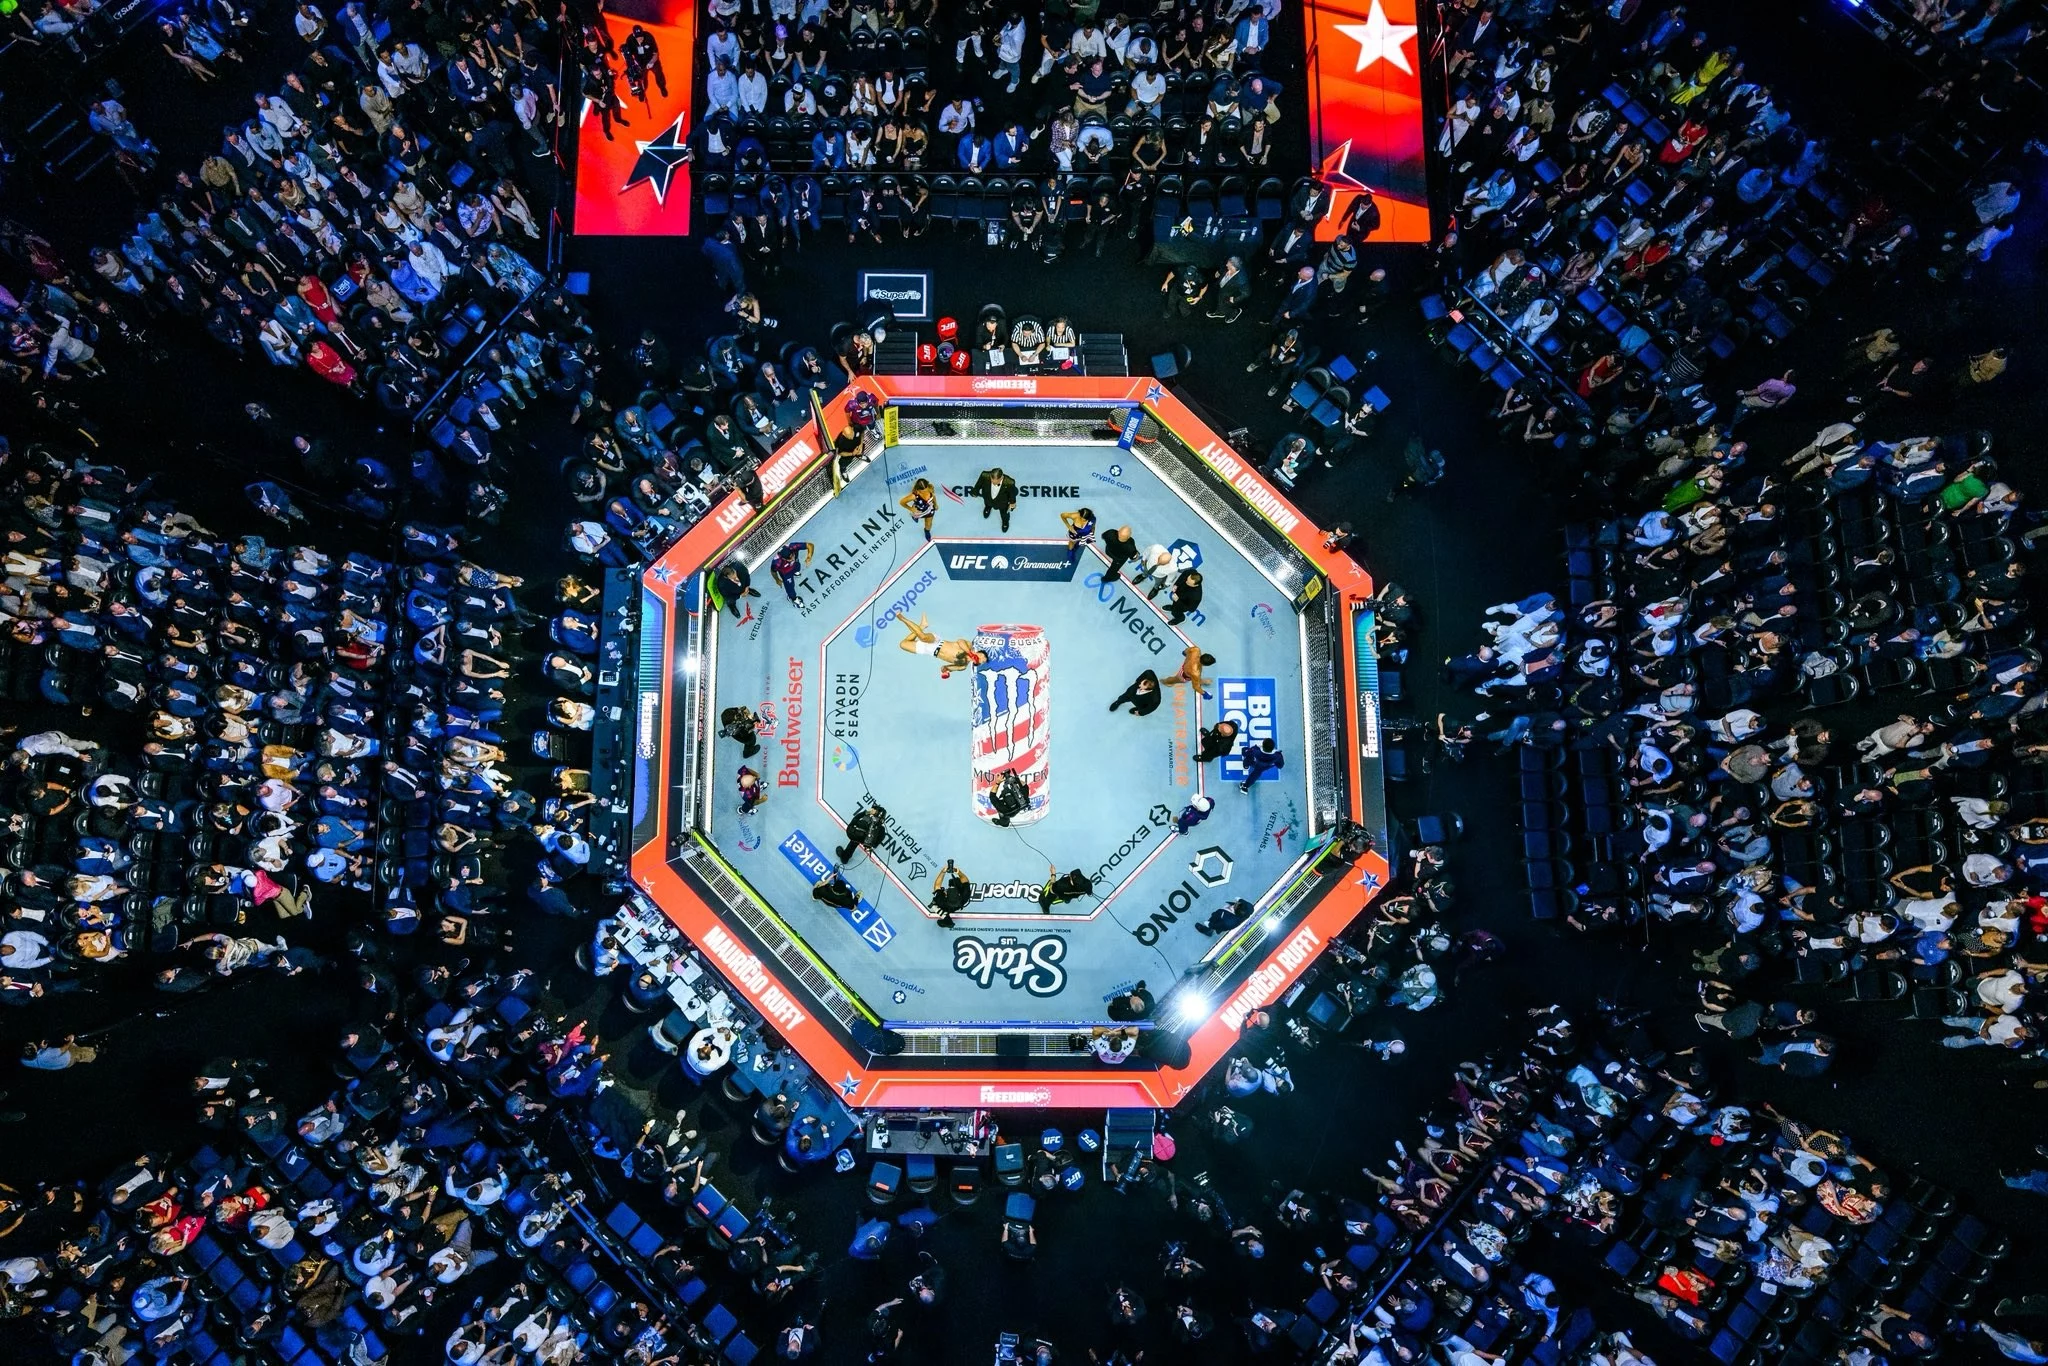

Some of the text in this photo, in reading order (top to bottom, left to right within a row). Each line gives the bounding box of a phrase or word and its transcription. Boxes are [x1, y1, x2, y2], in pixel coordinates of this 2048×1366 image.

[941, 321, 957, 332] UFC
[923, 344, 931, 361] UFC
[956, 351, 967, 369] UFC
[989, 379, 1037, 389] FREEDOM
[896, 464, 929, 482] AMSTERDAM
[1198, 440, 1243, 479] RUFFY
[951, 484, 1080, 499] CRSTRIKE
[1091, 470, 1132, 492] crypto.com
[714, 495, 753, 533] UFFY
[797, 502, 898, 604] TARLINK
[800, 517, 906, 618] FAST AFFORDABLE INTERNET
[950, 555, 1072, 571] UFC Paramount+
[875, 568, 939, 630] easypost
[978, 637, 1043, 647] ZERO SUGAR
[1108, 595, 1167, 656] Meta
[641, 691, 653, 742] FREEDOM
[778, 656, 805, 789] Budweiser
[835, 673, 847, 738] RIYADH
[848, 673, 860, 738] SEASON
[1172, 684, 1190, 788] INJATRADER
[1365, 705, 1379, 758] FREEDOM
[851, 801, 912, 864] ANDL
[891, 825, 922, 855] FIGHT
[1089, 824, 1151, 886] EXODUS
[1132, 880, 1201, 947] IONQ
[956, 937, 1064, 994] Stake
[1275, 925, 1321, 980] RUFFY
[883, 973, 926, 995] crypto.com
[760, 985, 807, 1032] RUFFY
[980, 1091, 1036, 1103] FREEDOM
[1043, 1135, 1061, 1145] UFC
[1081, 1133, 1098, 1149] UFC
[1065, 1171, 1082, 1186] UFC
